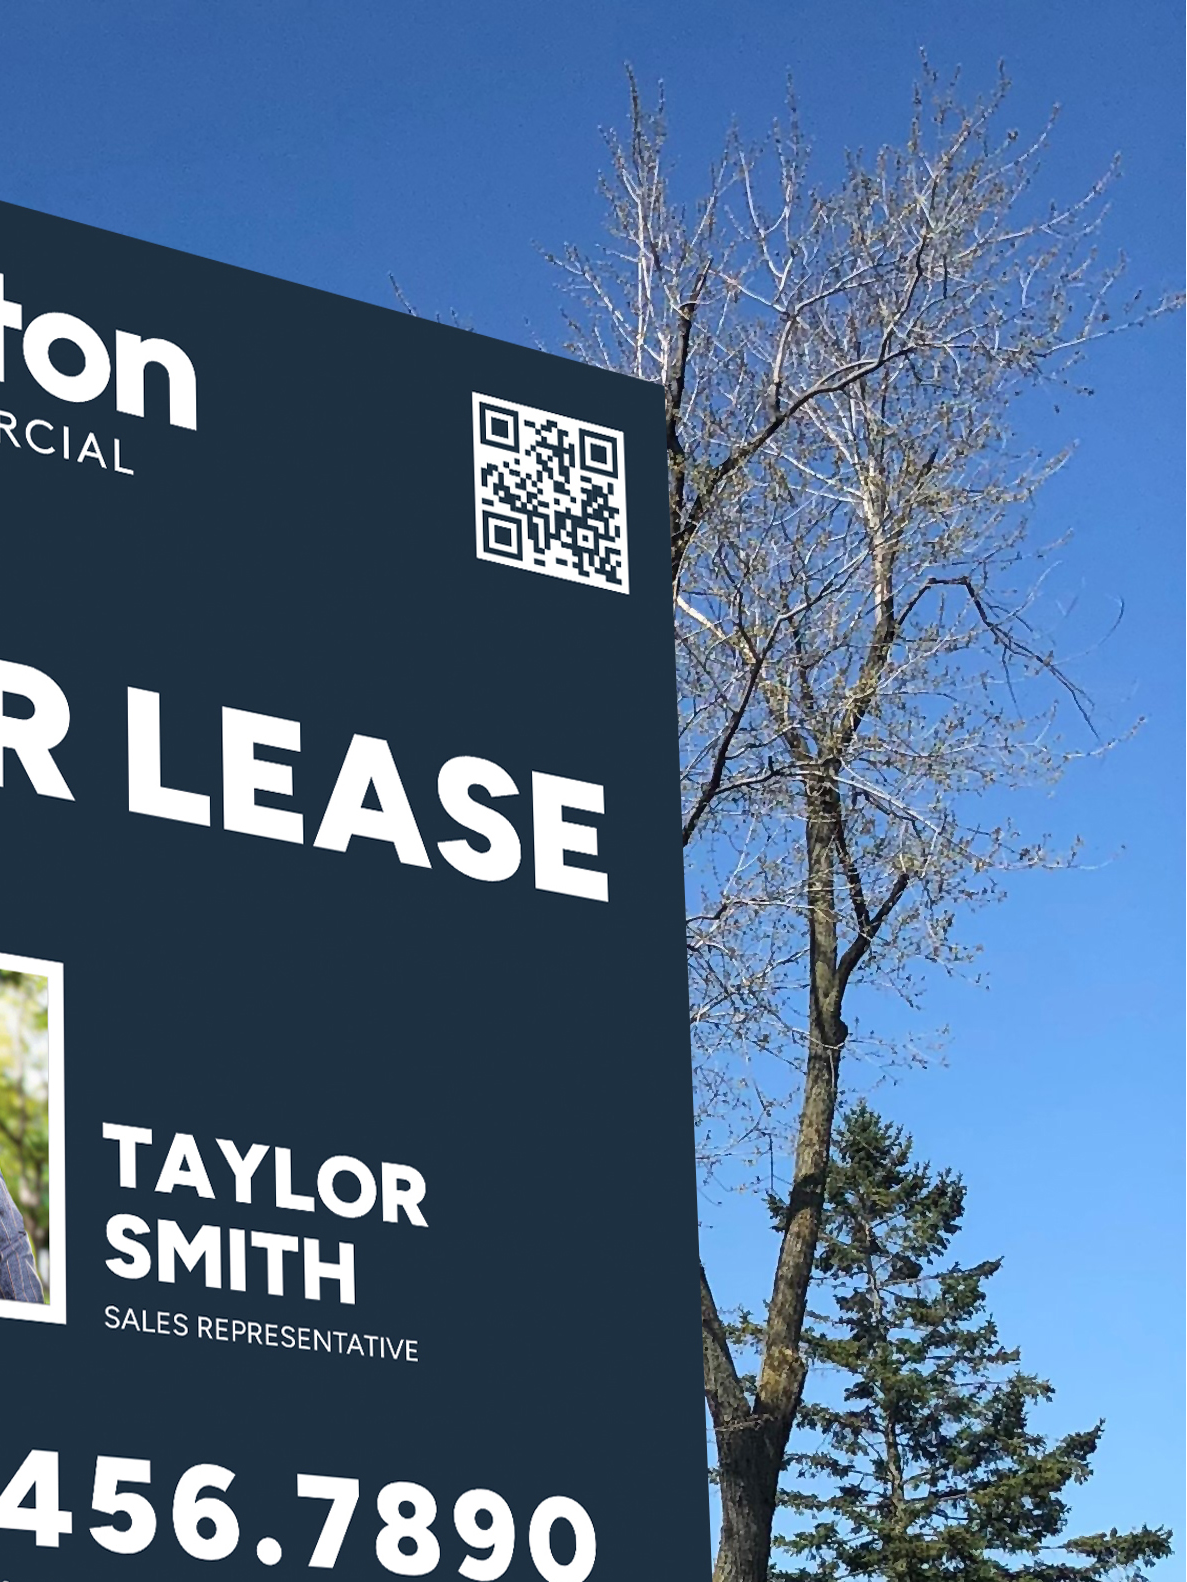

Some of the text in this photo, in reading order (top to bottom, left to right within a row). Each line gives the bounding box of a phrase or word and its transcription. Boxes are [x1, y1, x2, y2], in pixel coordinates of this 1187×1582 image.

[127, 686, 609, 903] LEASE
[102, 1121, 429, 1228] TAYLOR
[105, 1213, 356, 1305] SMITH
[104, 1305, 419, 1362] SALES REPRESENTATIVE
